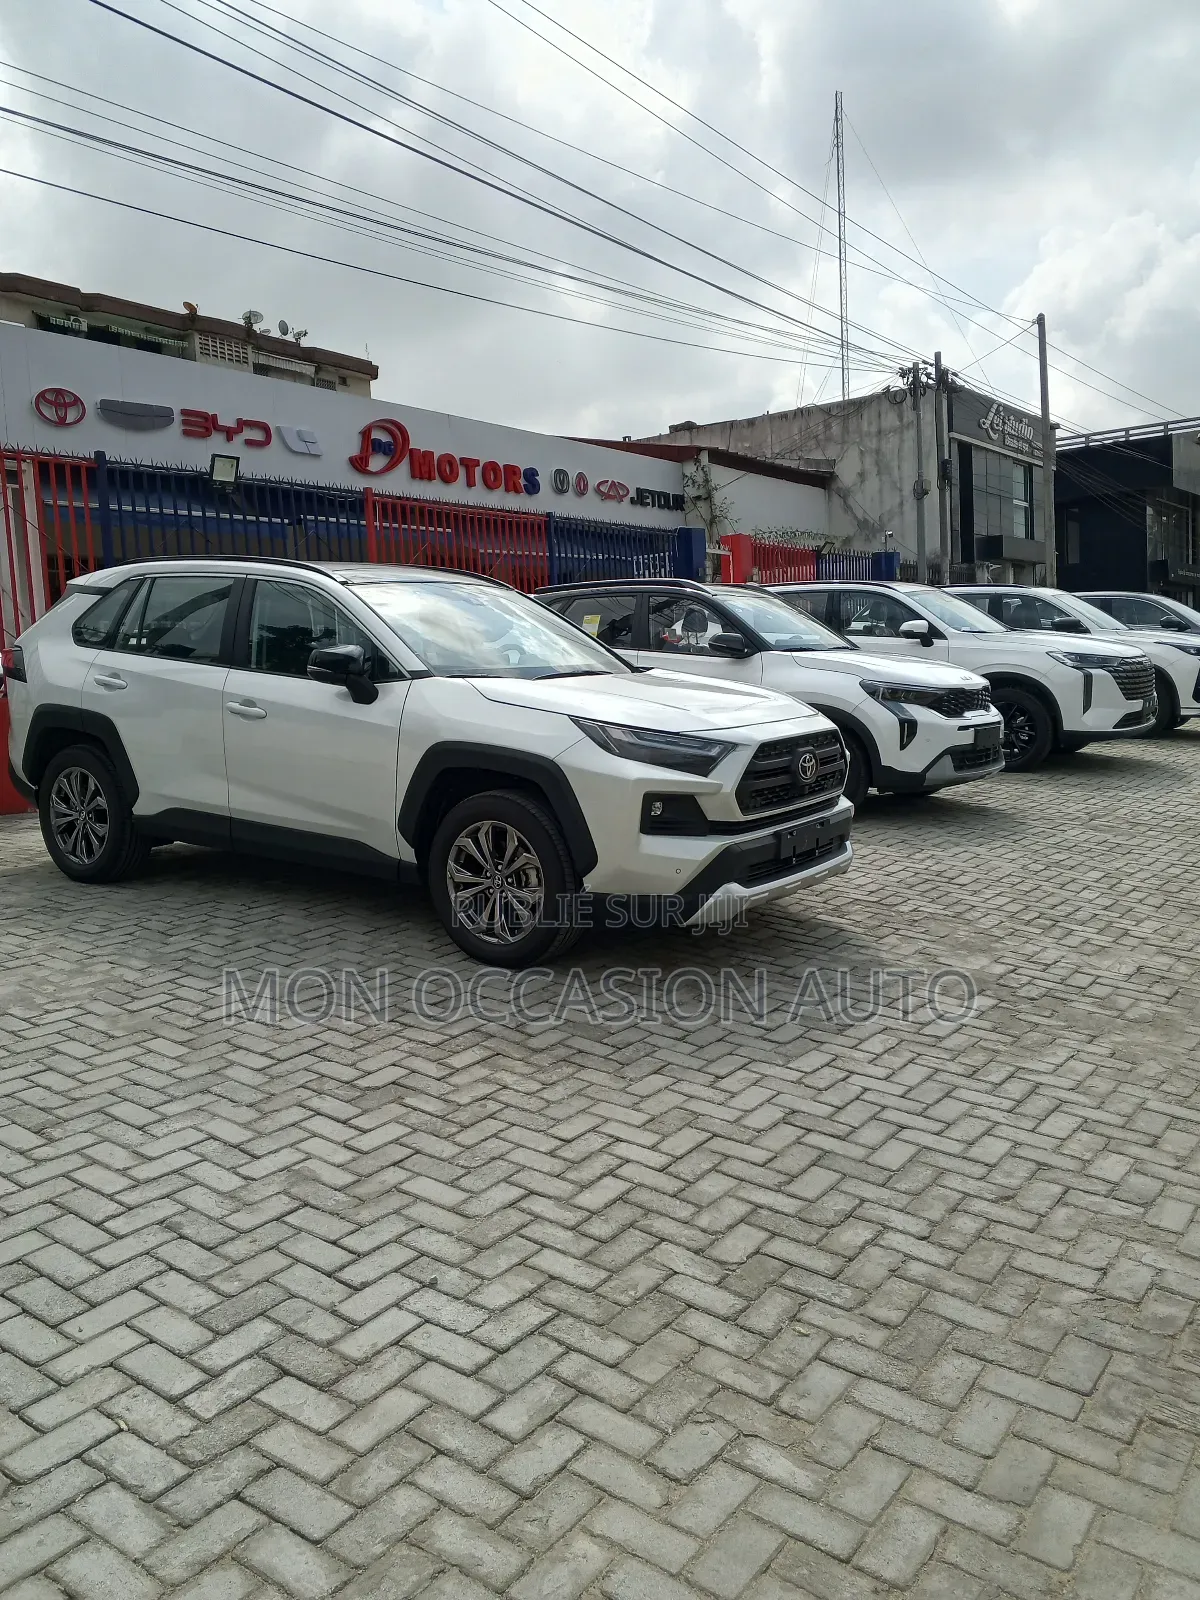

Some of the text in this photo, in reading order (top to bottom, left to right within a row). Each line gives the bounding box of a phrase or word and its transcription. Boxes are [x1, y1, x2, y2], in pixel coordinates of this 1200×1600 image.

[180, 408, 272, 447] BYD
[409, 447, 541, 495] MOTORS
[629, 487, 686, 512] JETOUR
